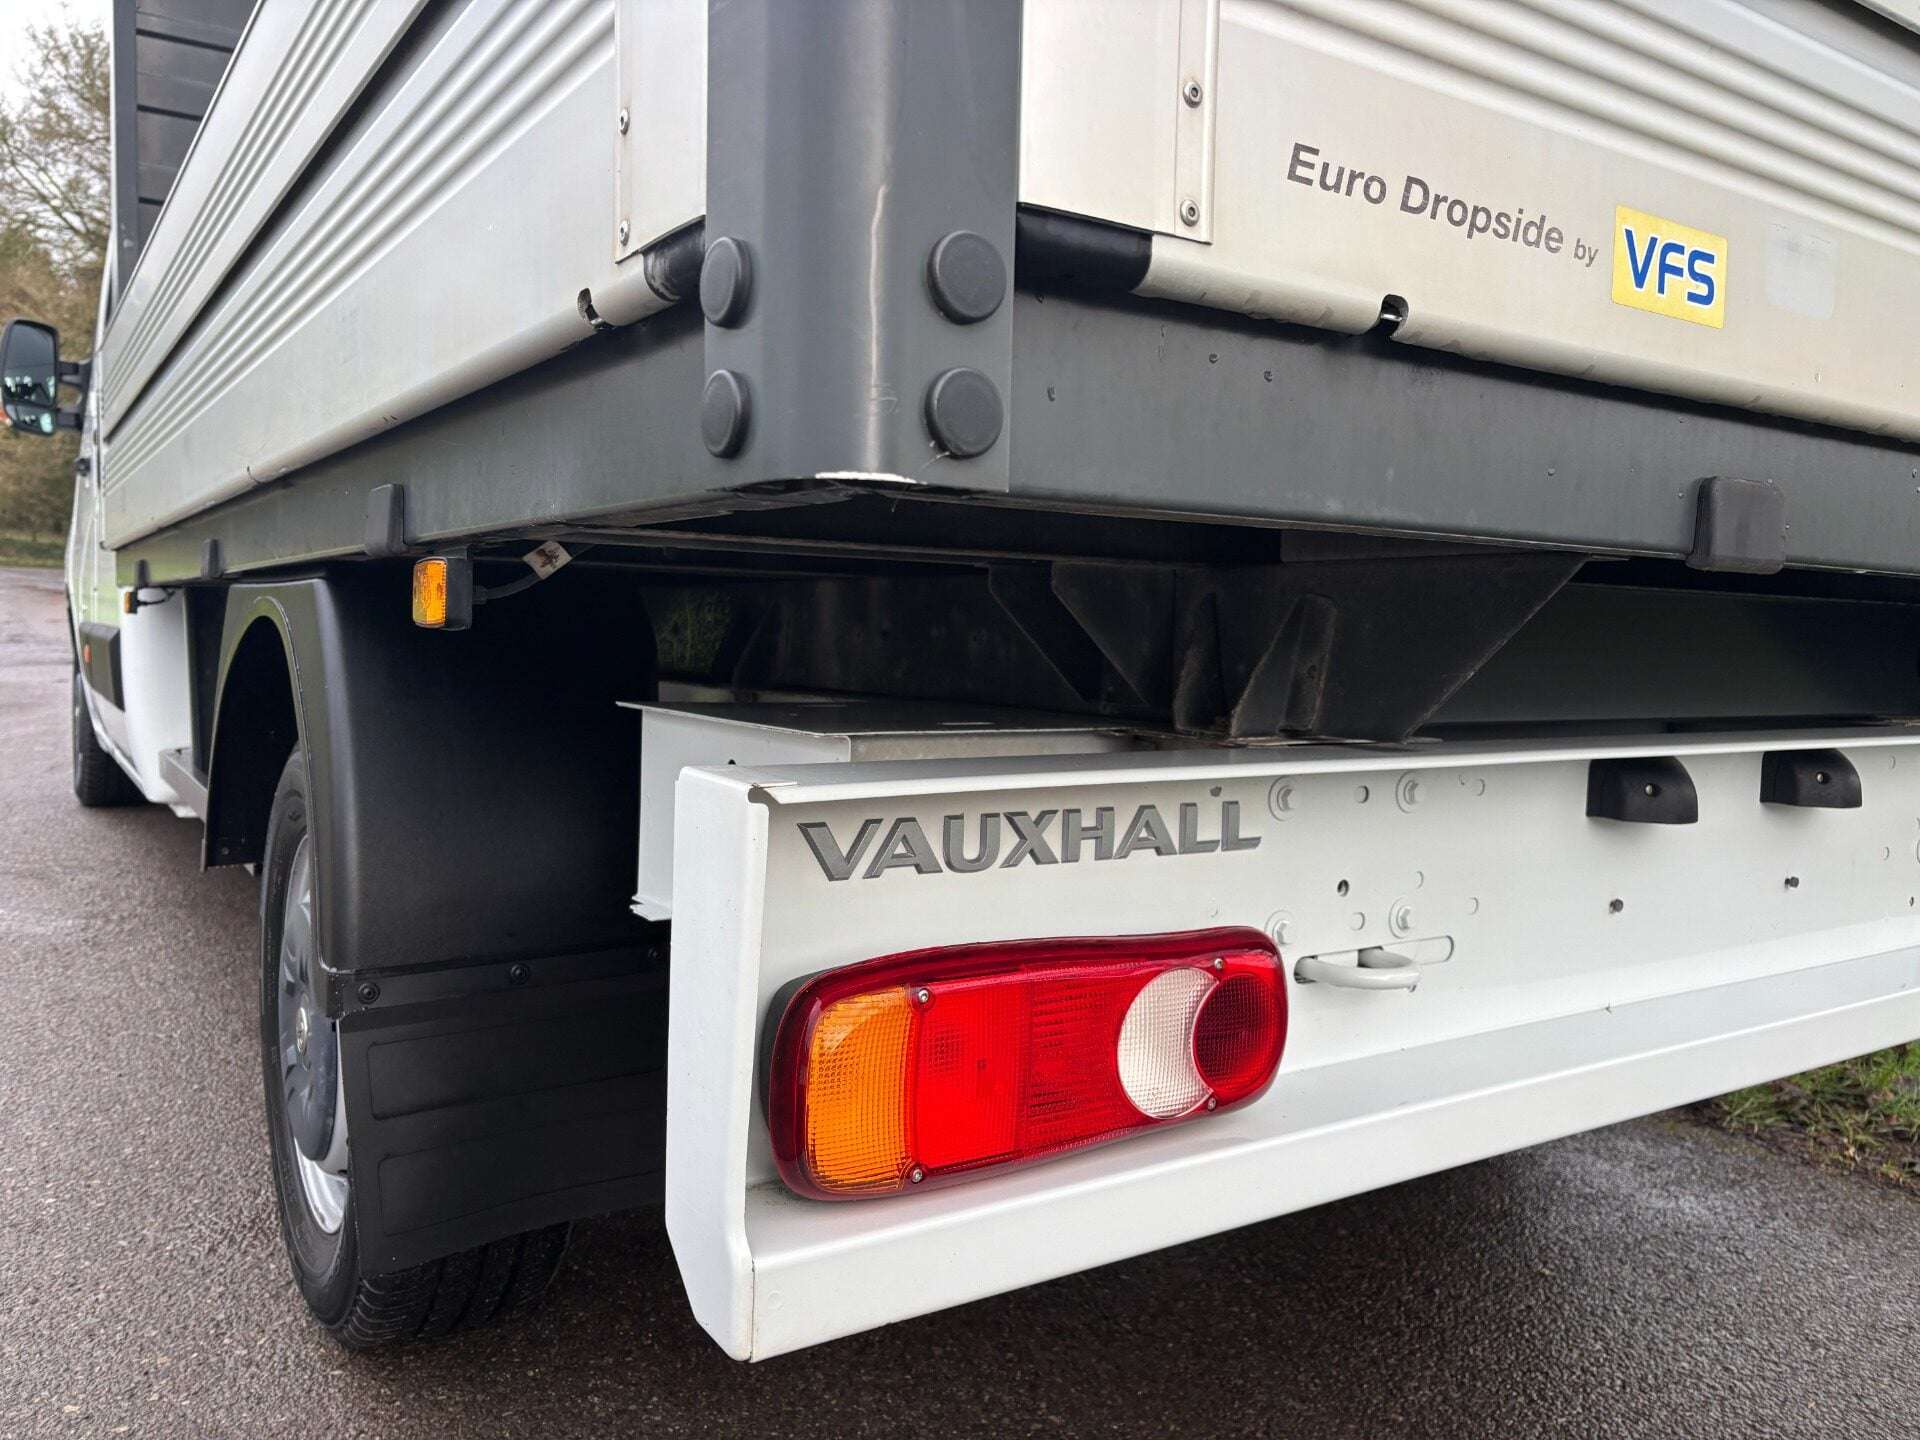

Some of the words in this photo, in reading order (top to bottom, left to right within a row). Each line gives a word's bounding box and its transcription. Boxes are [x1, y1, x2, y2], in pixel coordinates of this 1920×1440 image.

[1287, 141, 1388, 205] Euro
[1399, 176, 1565, 254] Dropside
[1573, 237, 1599, 268] by
[1622, 226, 1716, 306] VFS
[796, 800, 1262, 882] VAUXHALL
